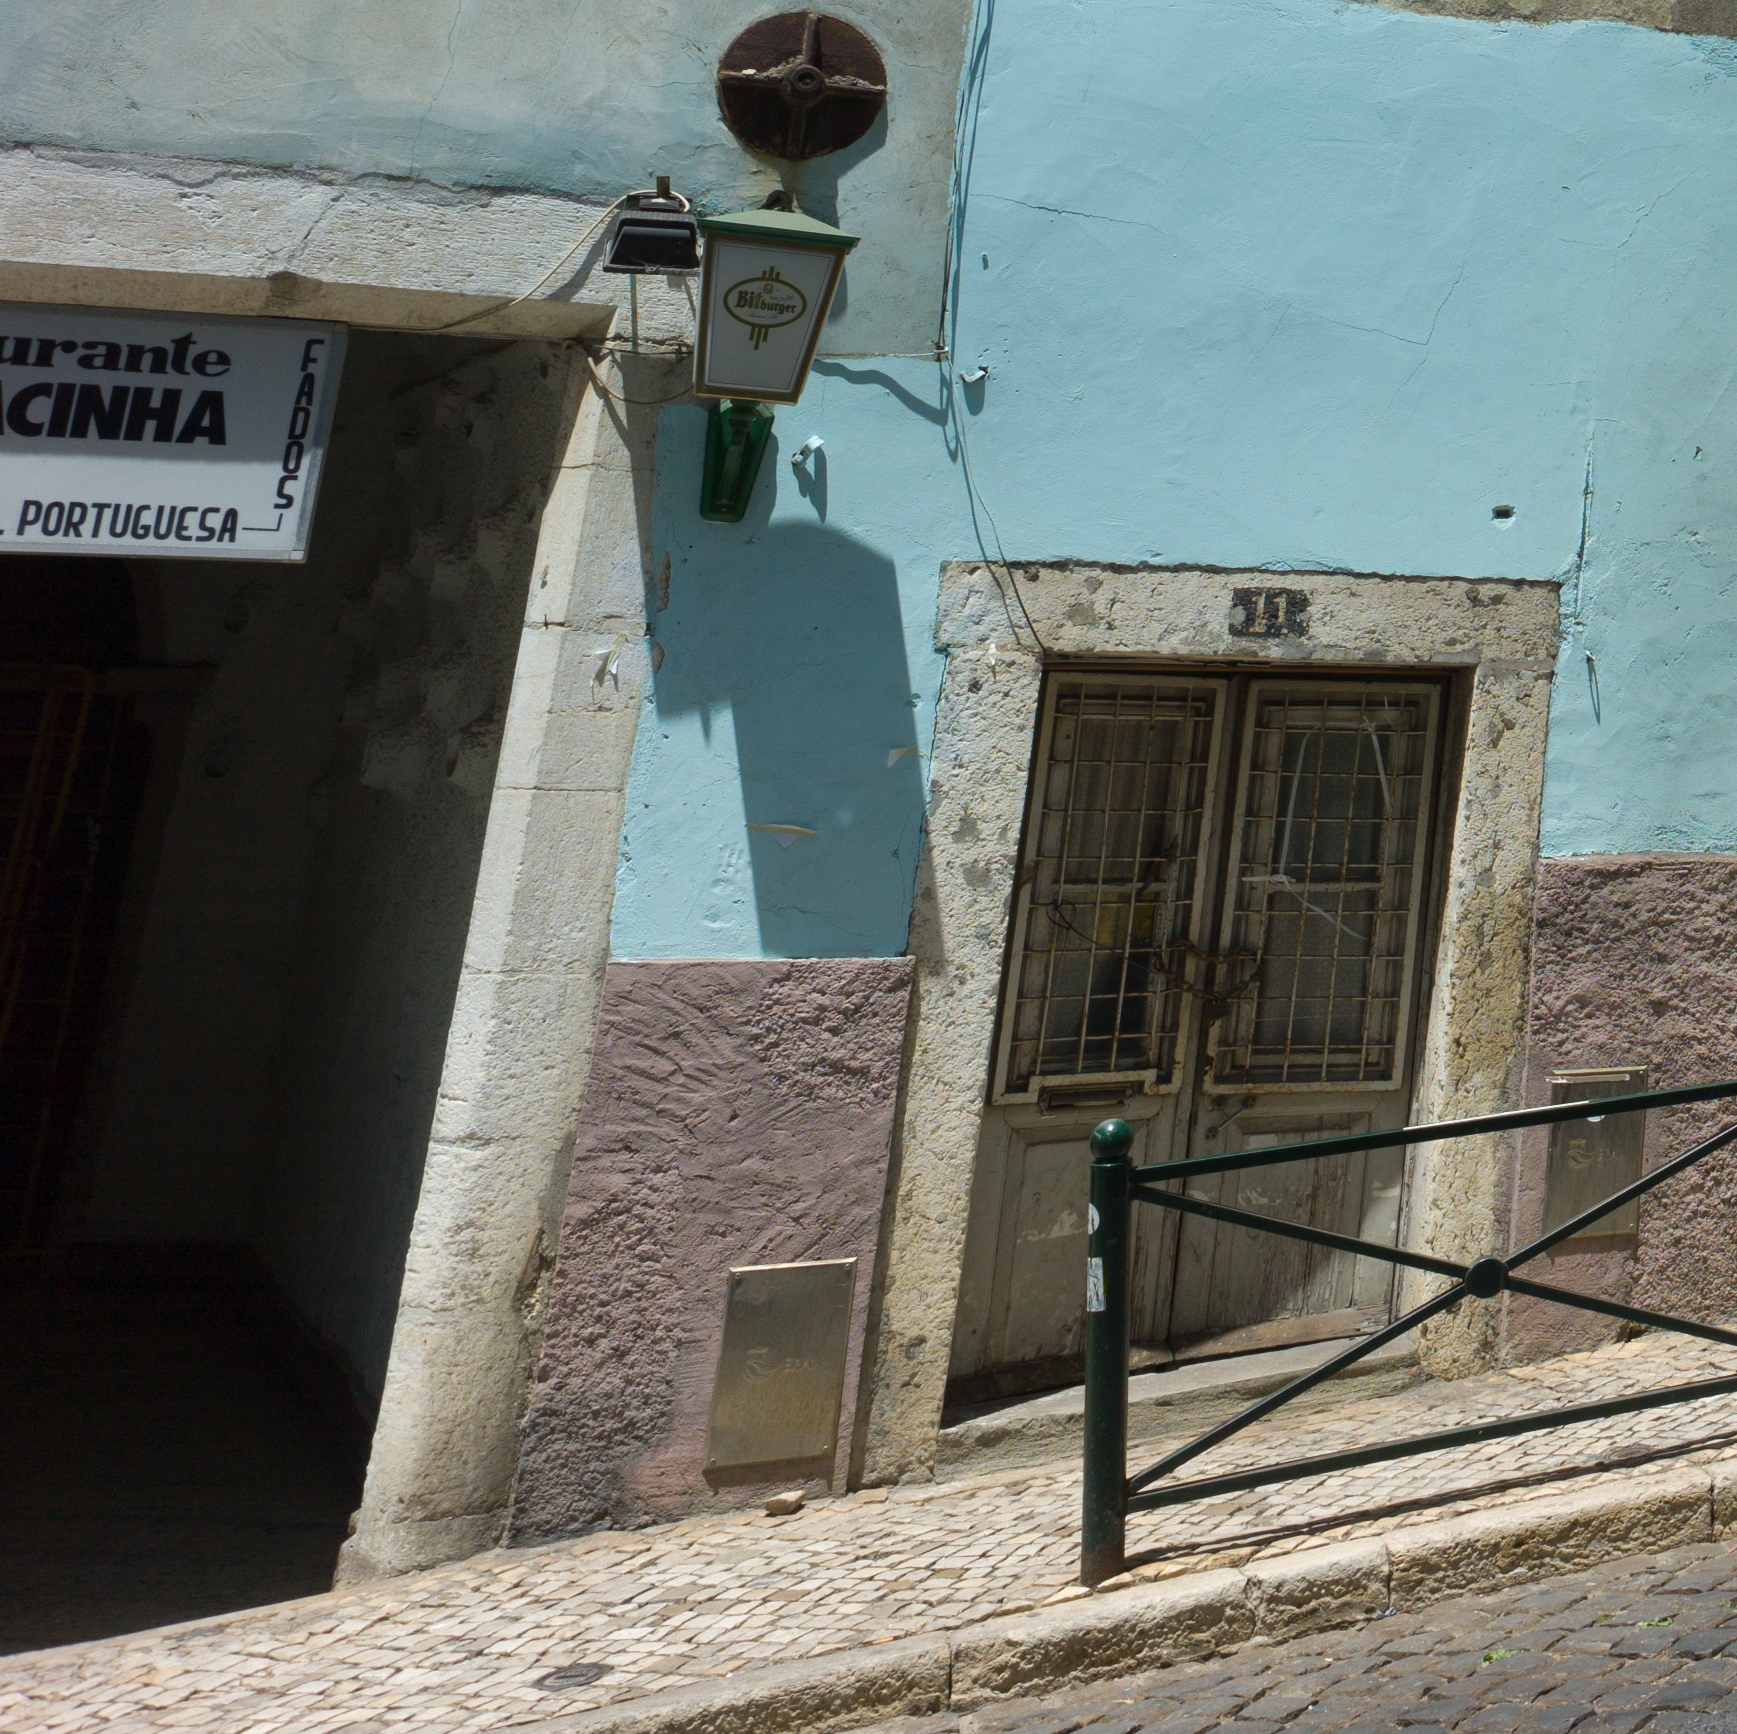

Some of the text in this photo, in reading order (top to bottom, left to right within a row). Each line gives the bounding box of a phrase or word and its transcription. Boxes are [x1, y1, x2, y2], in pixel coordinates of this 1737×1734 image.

[734, 289, 797, 315] Bitburger
[0, 332, 232, 378] urante
[0, 382, 227, 446] CINHA
[273, 338, 326, 510] FADOS
[16, 499, 239, 543] PORTUGUESA
[1248, 592, 1289, 635] 11
